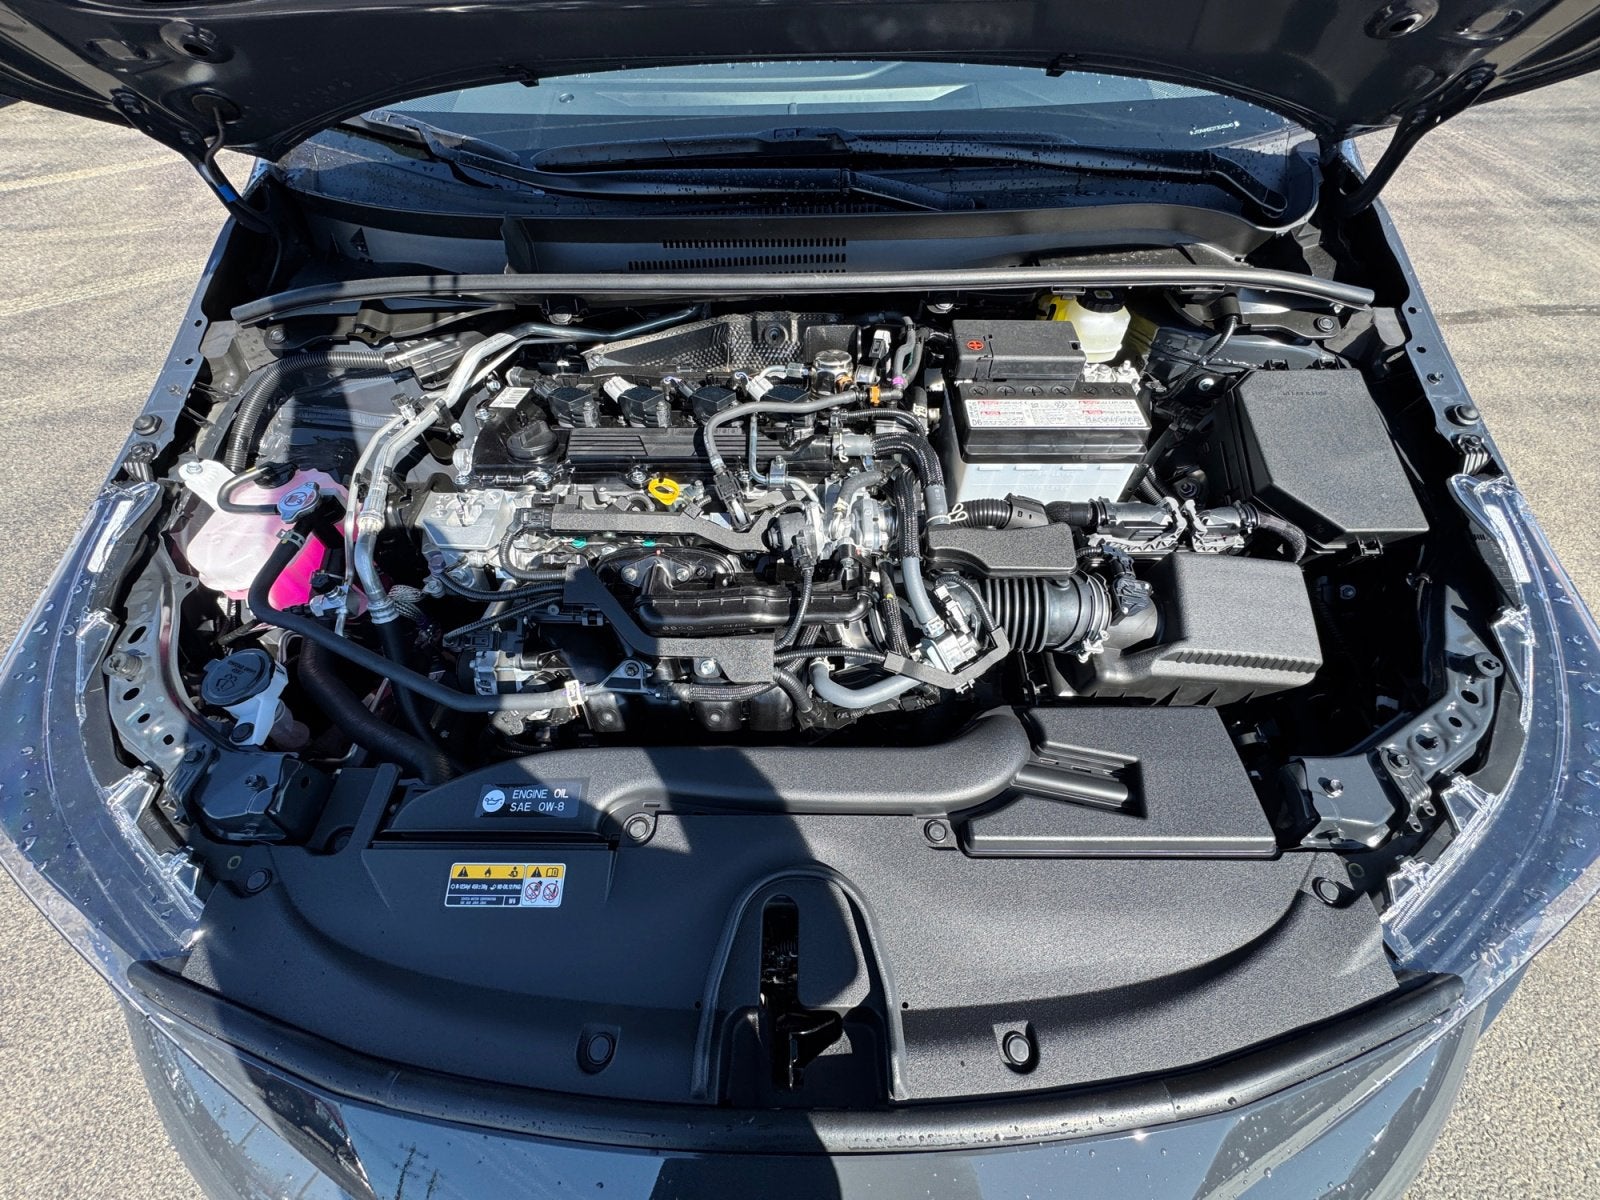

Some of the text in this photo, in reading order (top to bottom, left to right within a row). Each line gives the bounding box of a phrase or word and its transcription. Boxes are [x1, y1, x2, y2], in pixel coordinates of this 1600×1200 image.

[512, 788, 569, 799] ENGINE OIL
[510, 802, 532, 812] SAE
